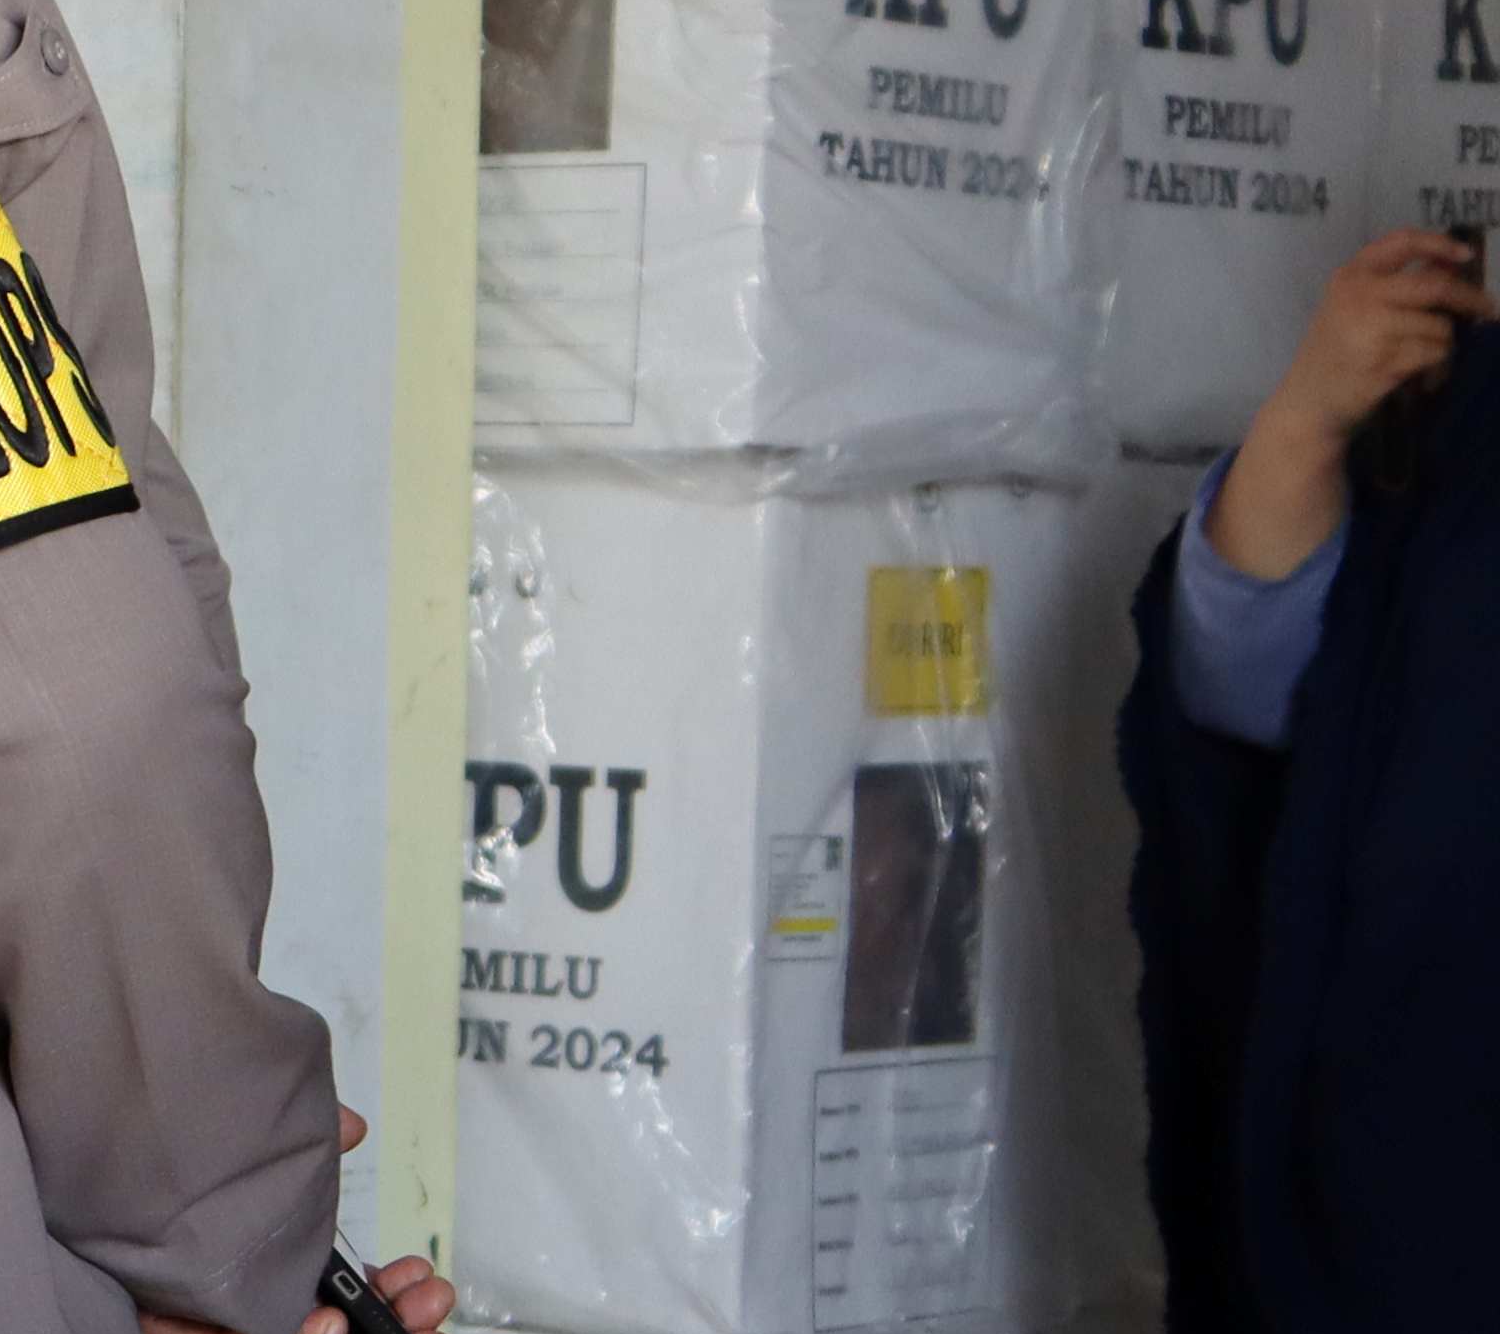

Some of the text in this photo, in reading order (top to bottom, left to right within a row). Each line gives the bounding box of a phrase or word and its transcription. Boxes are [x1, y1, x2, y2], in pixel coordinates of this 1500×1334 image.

[866, 65, 1013, 127] PEMILU
[1163, 93, 1294, 149] PEMILU
[818, 130, 953, 190] TAHUN
[1122, 156, 1331, 217] TAHUN 2024
[1417, 185, 1500, 227] TAH
[463, 759, 650, 915] PU
[460, 947, 604, 1000] MILU
[529, 1023, 670, 1078] 2024
